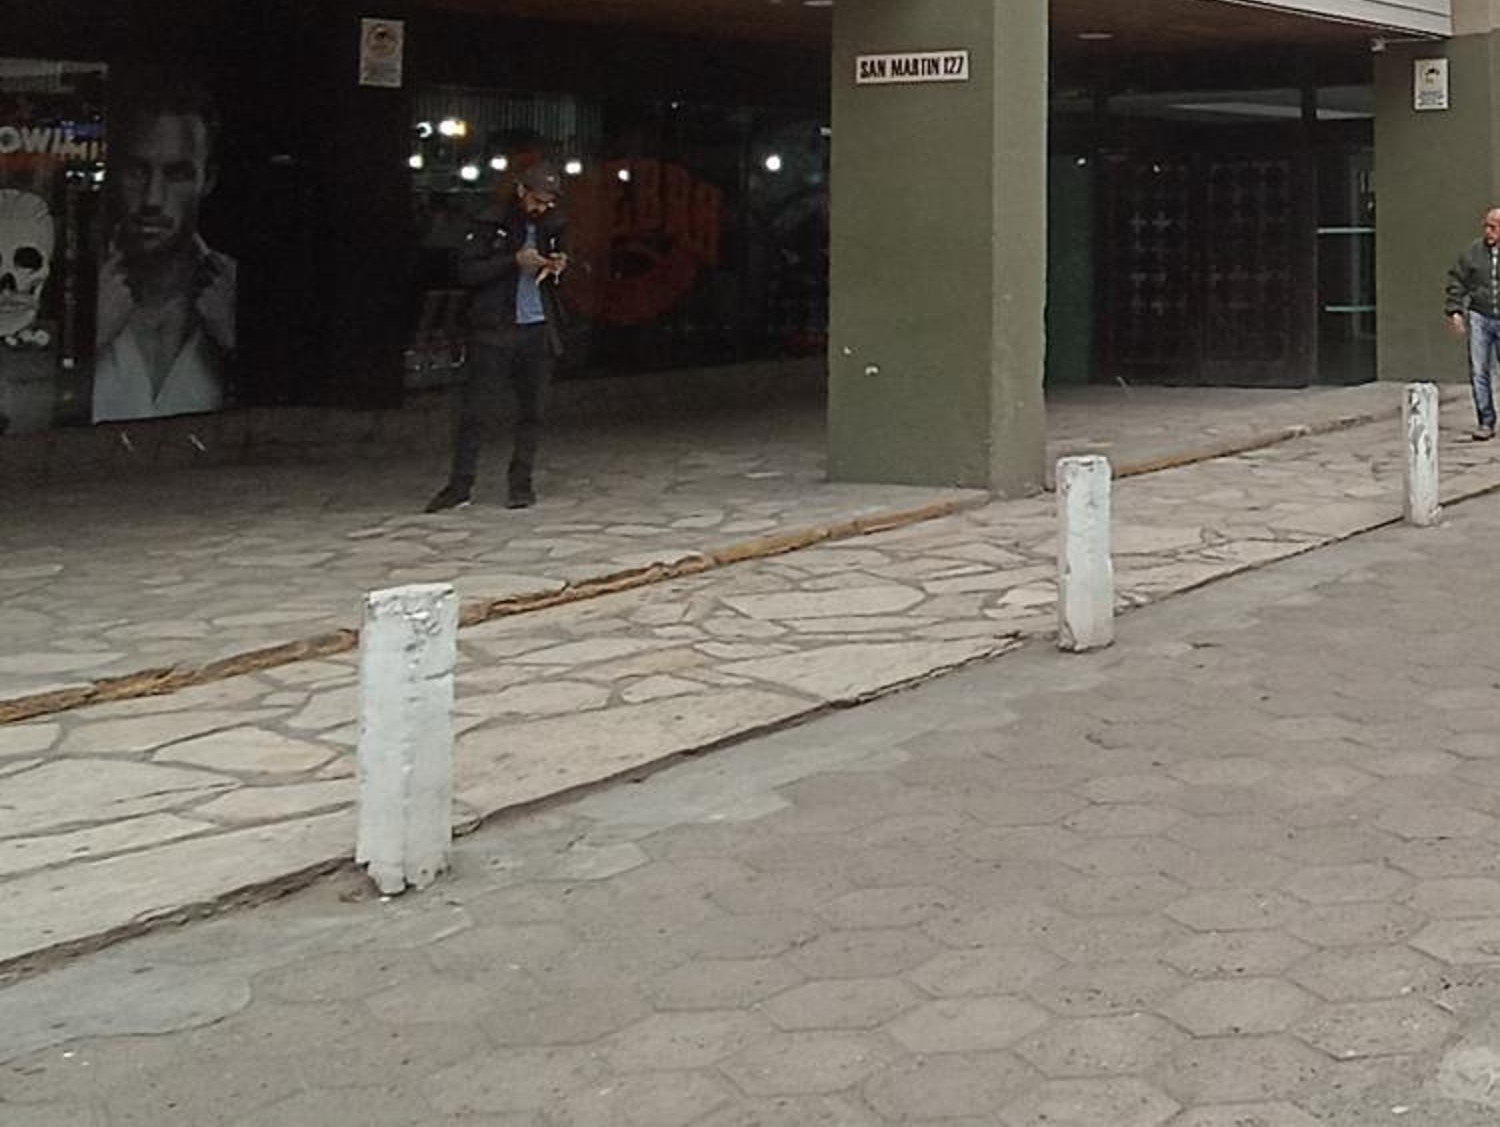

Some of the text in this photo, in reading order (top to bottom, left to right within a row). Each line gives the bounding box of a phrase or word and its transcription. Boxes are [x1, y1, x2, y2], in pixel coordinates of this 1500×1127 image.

[860, 56, 964, 79] SAN MARTIN 127
